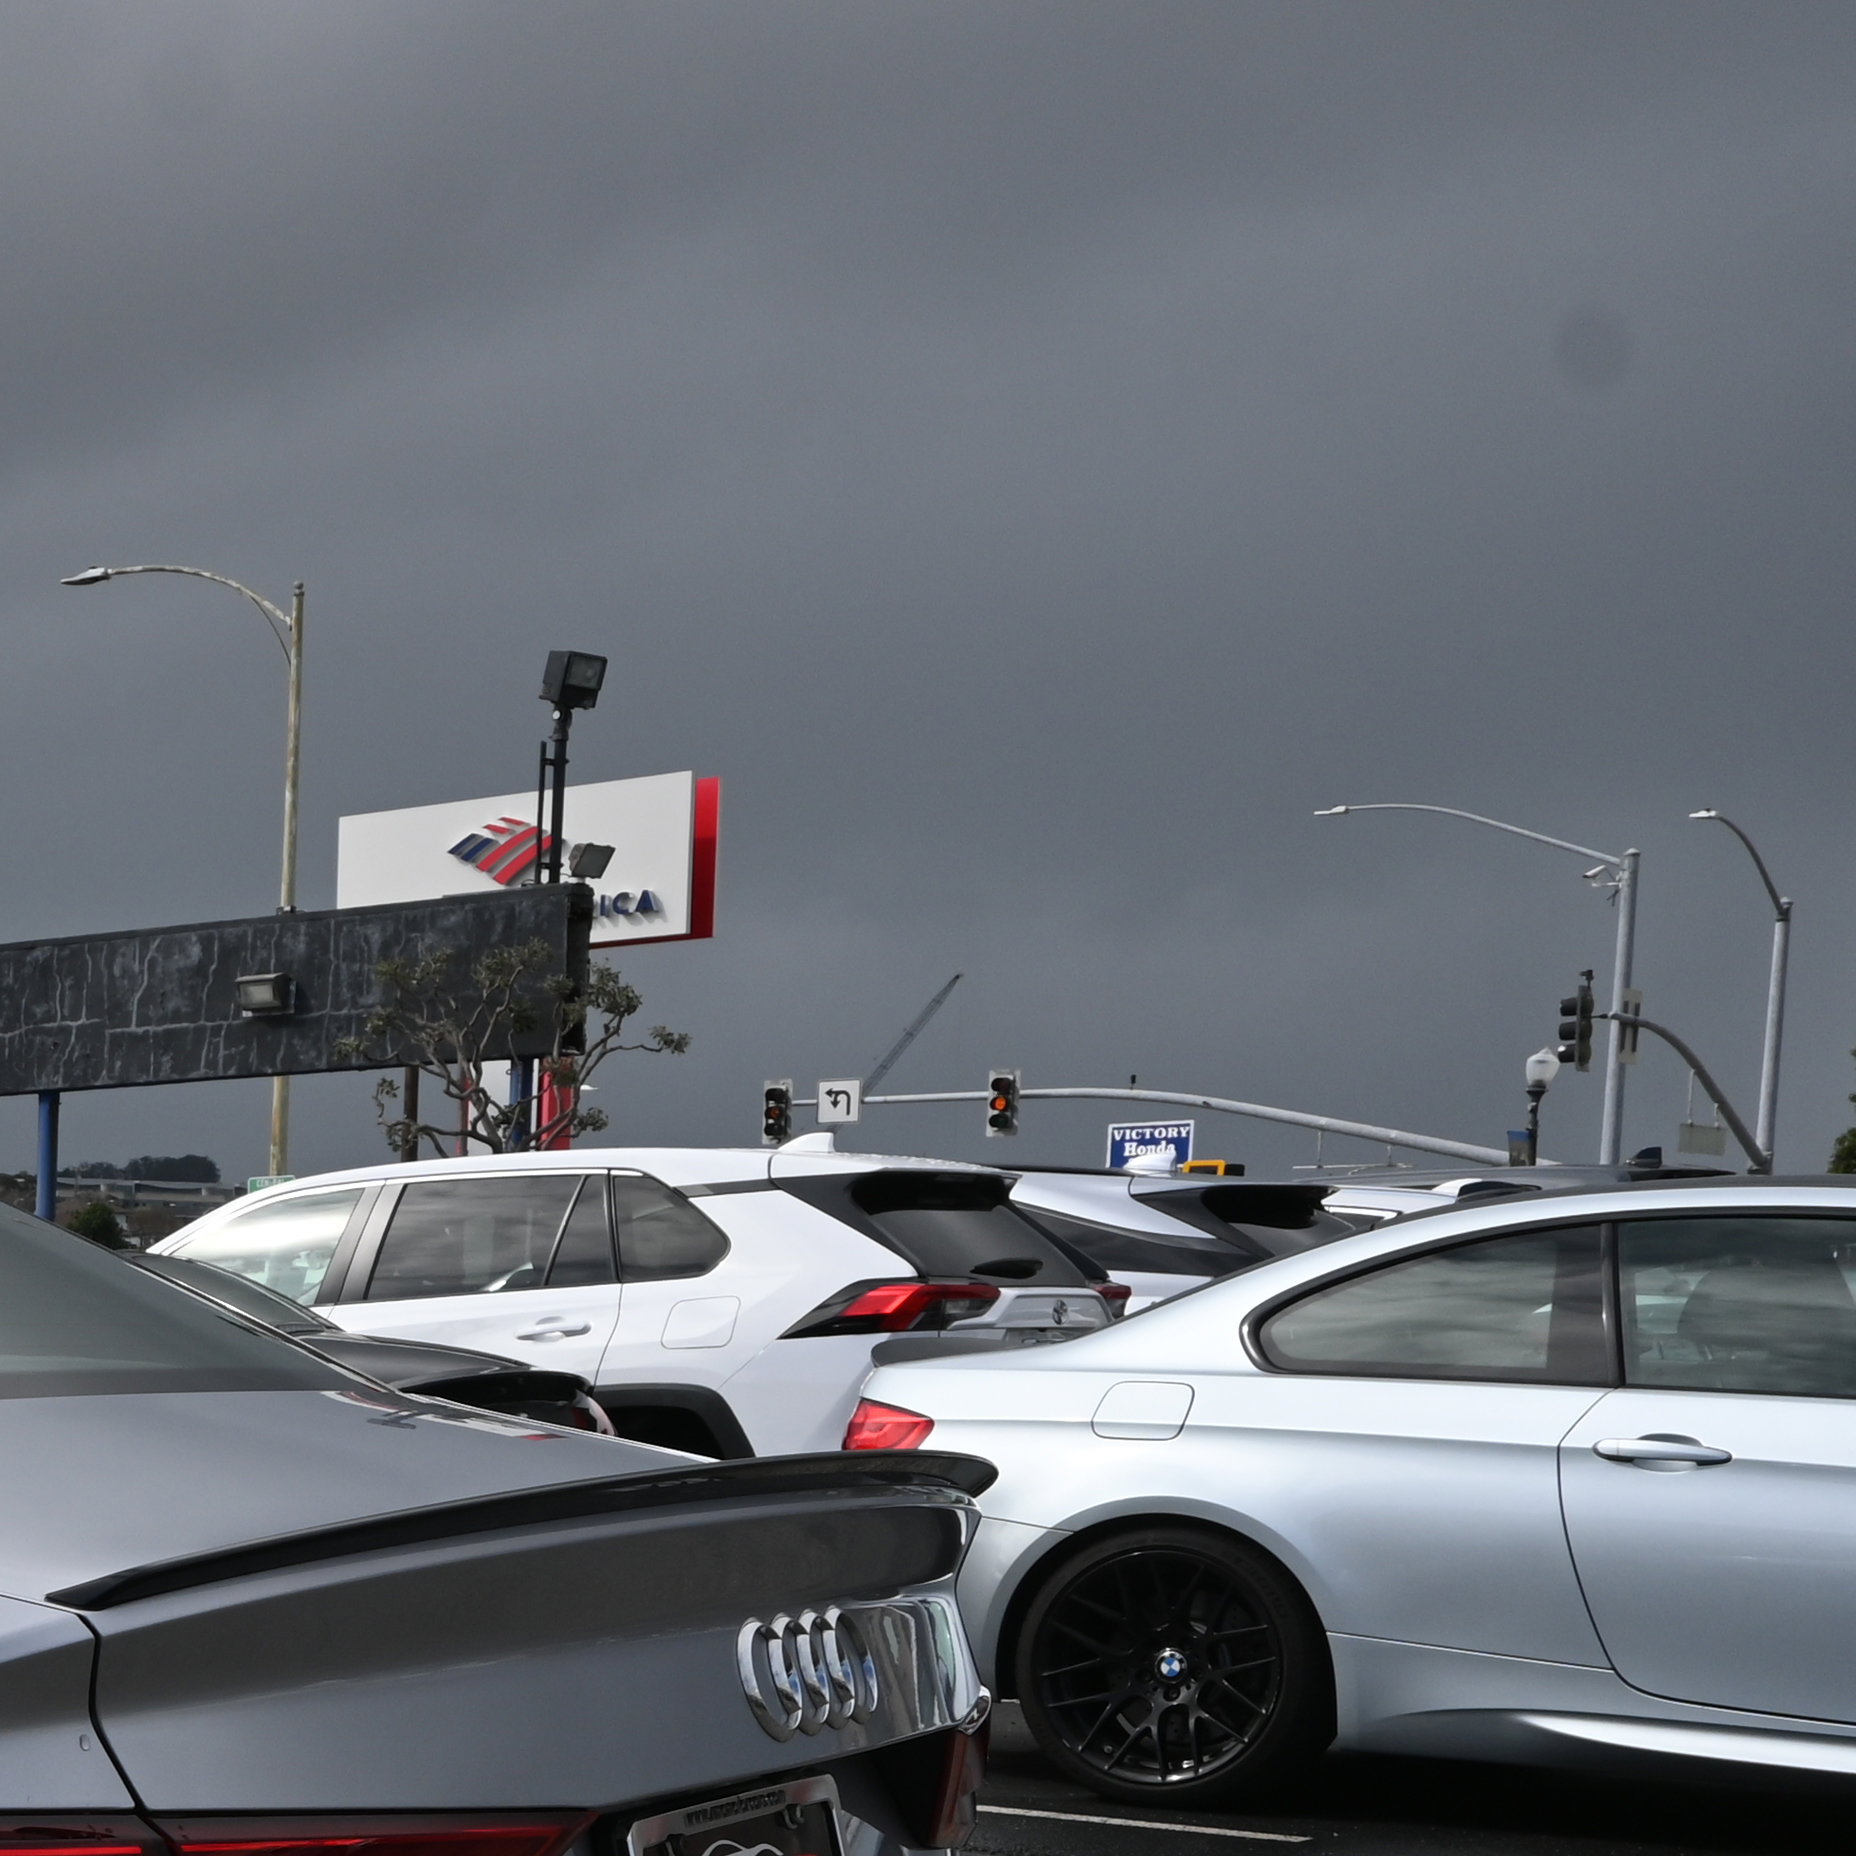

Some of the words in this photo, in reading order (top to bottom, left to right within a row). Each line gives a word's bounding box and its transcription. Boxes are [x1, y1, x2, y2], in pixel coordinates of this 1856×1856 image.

[593, 889, 660, 917] ICA
[1113, 1126, 1190, 1141] VICTORY
[1123, 1141, 1176, 1157] Honda
